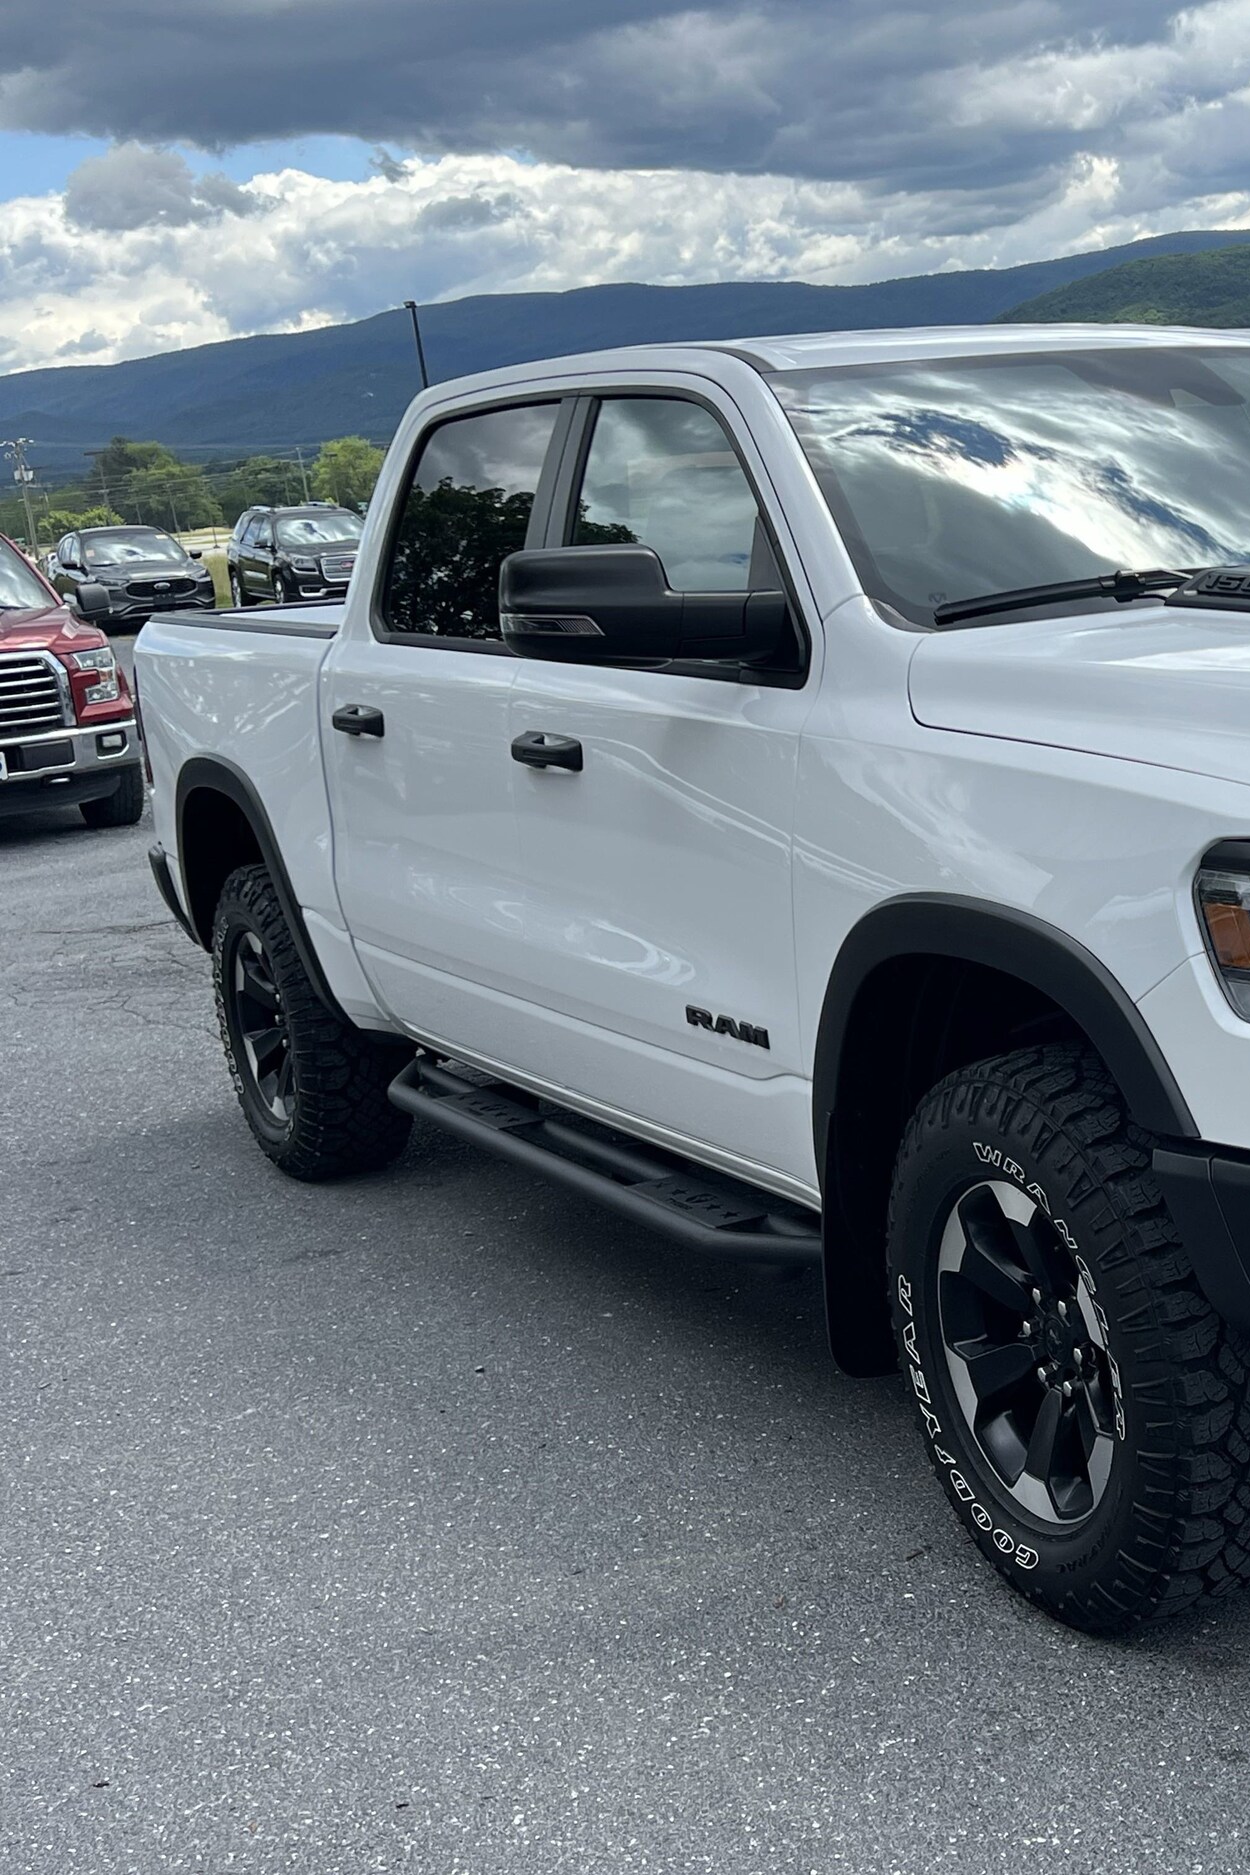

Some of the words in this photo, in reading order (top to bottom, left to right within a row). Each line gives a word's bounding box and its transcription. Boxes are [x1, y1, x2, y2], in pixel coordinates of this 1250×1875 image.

[685, 1004, 770, 1050] RAM
[897, 1274, 1040, 1571] GOODYEAR
[973, 1141, 1127, 1441] WRANGLER
